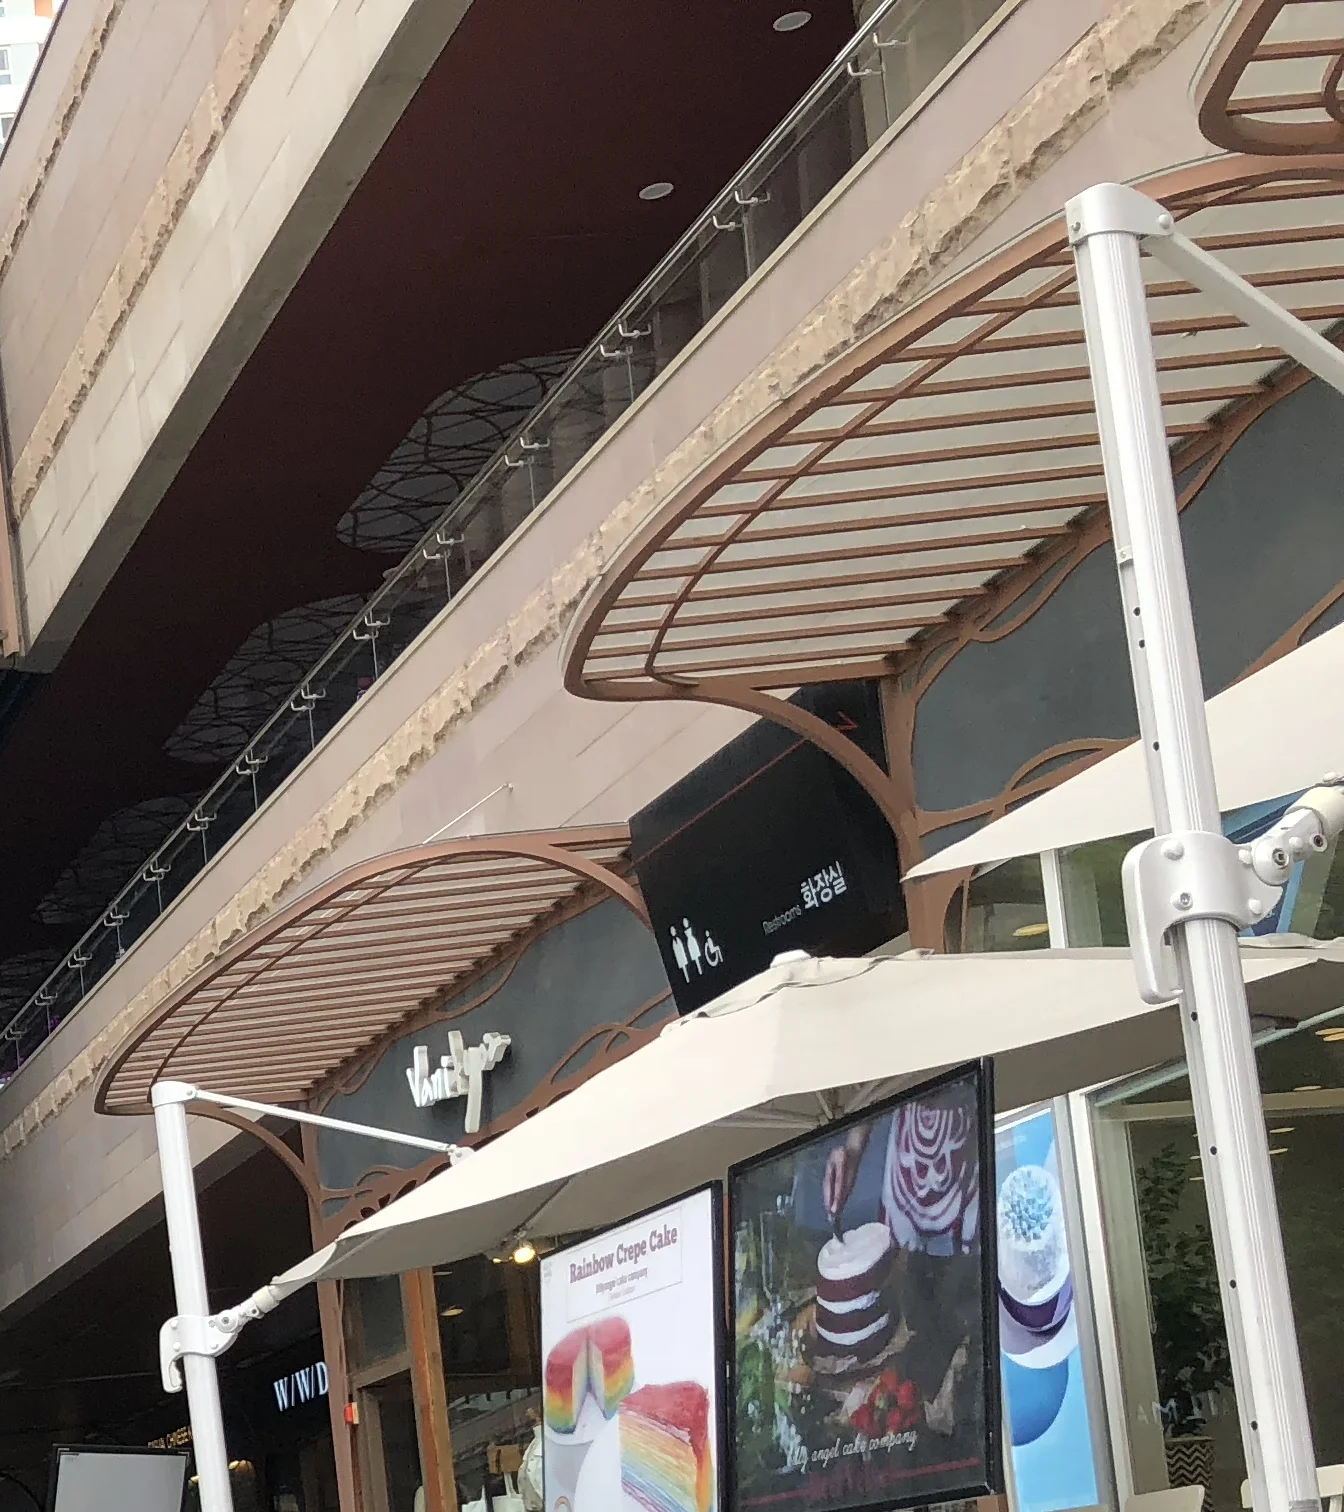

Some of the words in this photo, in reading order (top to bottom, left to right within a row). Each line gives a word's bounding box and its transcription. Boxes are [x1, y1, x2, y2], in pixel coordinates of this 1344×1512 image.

[800, 860, 848, 909] 화장실
[762, 904, 802, 936] Restrooms
[569, 1252, 614, 1284] Rainbow
[616, 1239, 647, 1265] Crepe
[649, 1224, 678, 1252] Cake
[811, 1437, 841, 1468] angel
[868, 1430, 917, 1453] company
